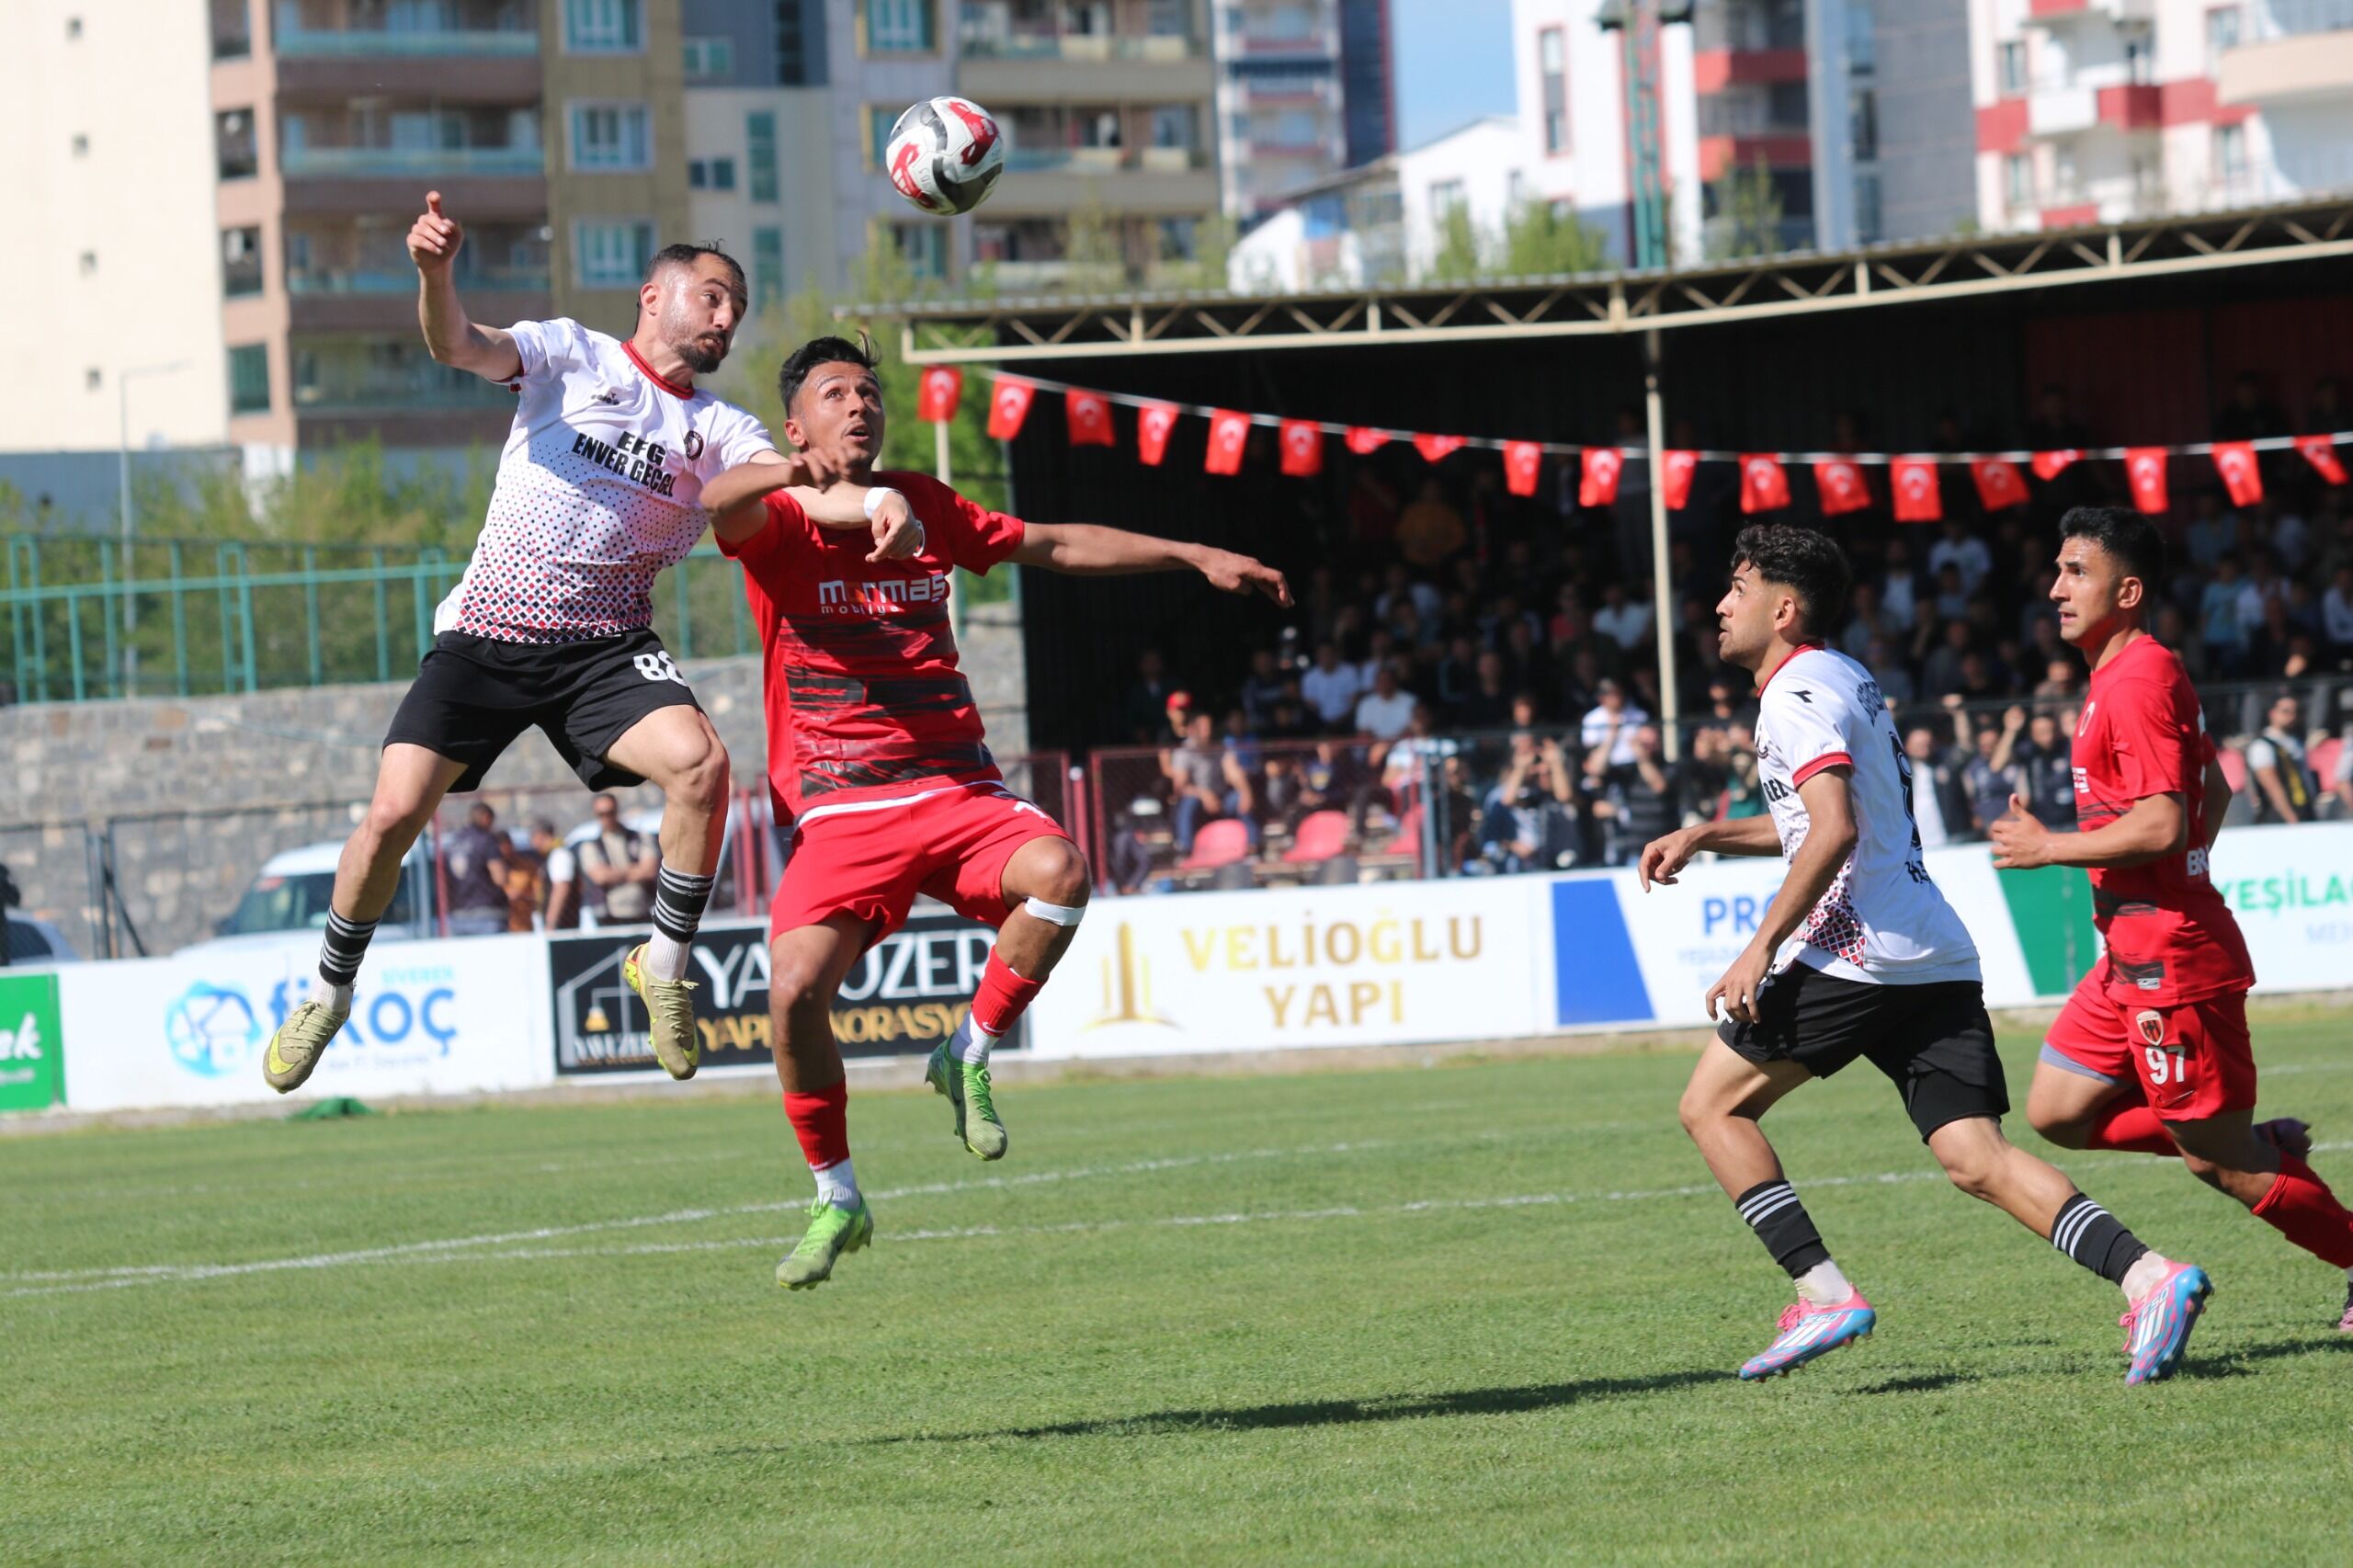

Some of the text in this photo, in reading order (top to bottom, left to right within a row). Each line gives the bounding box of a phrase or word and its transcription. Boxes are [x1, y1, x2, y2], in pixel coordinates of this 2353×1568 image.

[572, 432, 629, 477] ENVER
[617, 430, 666, 467] EFG
[2213, 867, 2353, 917] YEŞİLA
[1179, 906, 1483, 971] VELİOĞLU
[692, 927, 999, 1009] YAUZER
[1263, 979, 1404, 1029] YAPI
[696, 1013, 771, 1052] YAPI
[2144, 1044, 2186, 1085] 97
